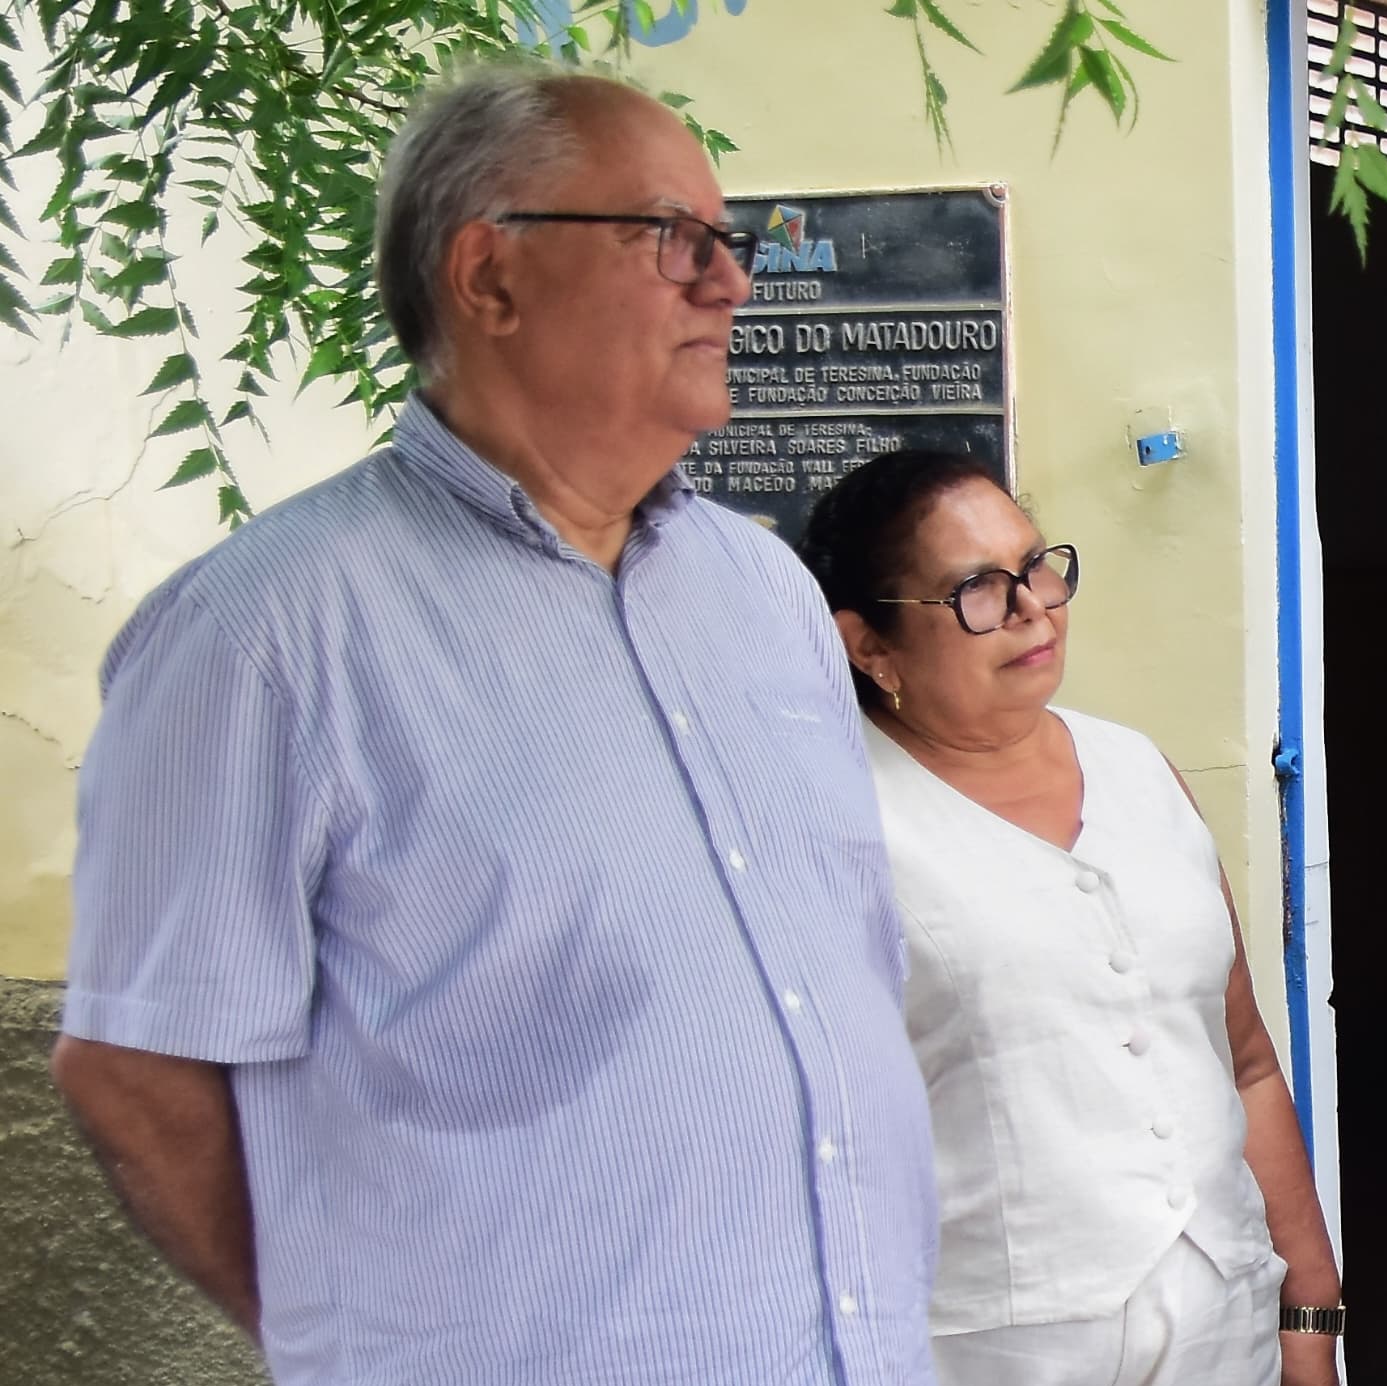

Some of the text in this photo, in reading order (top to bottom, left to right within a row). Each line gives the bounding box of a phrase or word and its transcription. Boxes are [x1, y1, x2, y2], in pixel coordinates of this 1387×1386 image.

[753, 281, 822, 301] FUTURO
[796, 323, 831, 353] DO
[841, 320, 997, 350] MATADOURO
[794, 366, 816, 383] DE
[749, 384, 828, 407] FUNDAÇÃO
[836, 383, 921, 405] CONCEIÇÃO
[931, 383, 983, 400] VIEIRA
[779, 423, 796, 436] DE
[708, 439, 777, 456] SILVEIRA
[787, 438, 847, 455] SOARES
[855, 436, 902, 453] FILHO
[704, 461, 723, 474] DA
[728, 477, 796, 493] MACEDO
